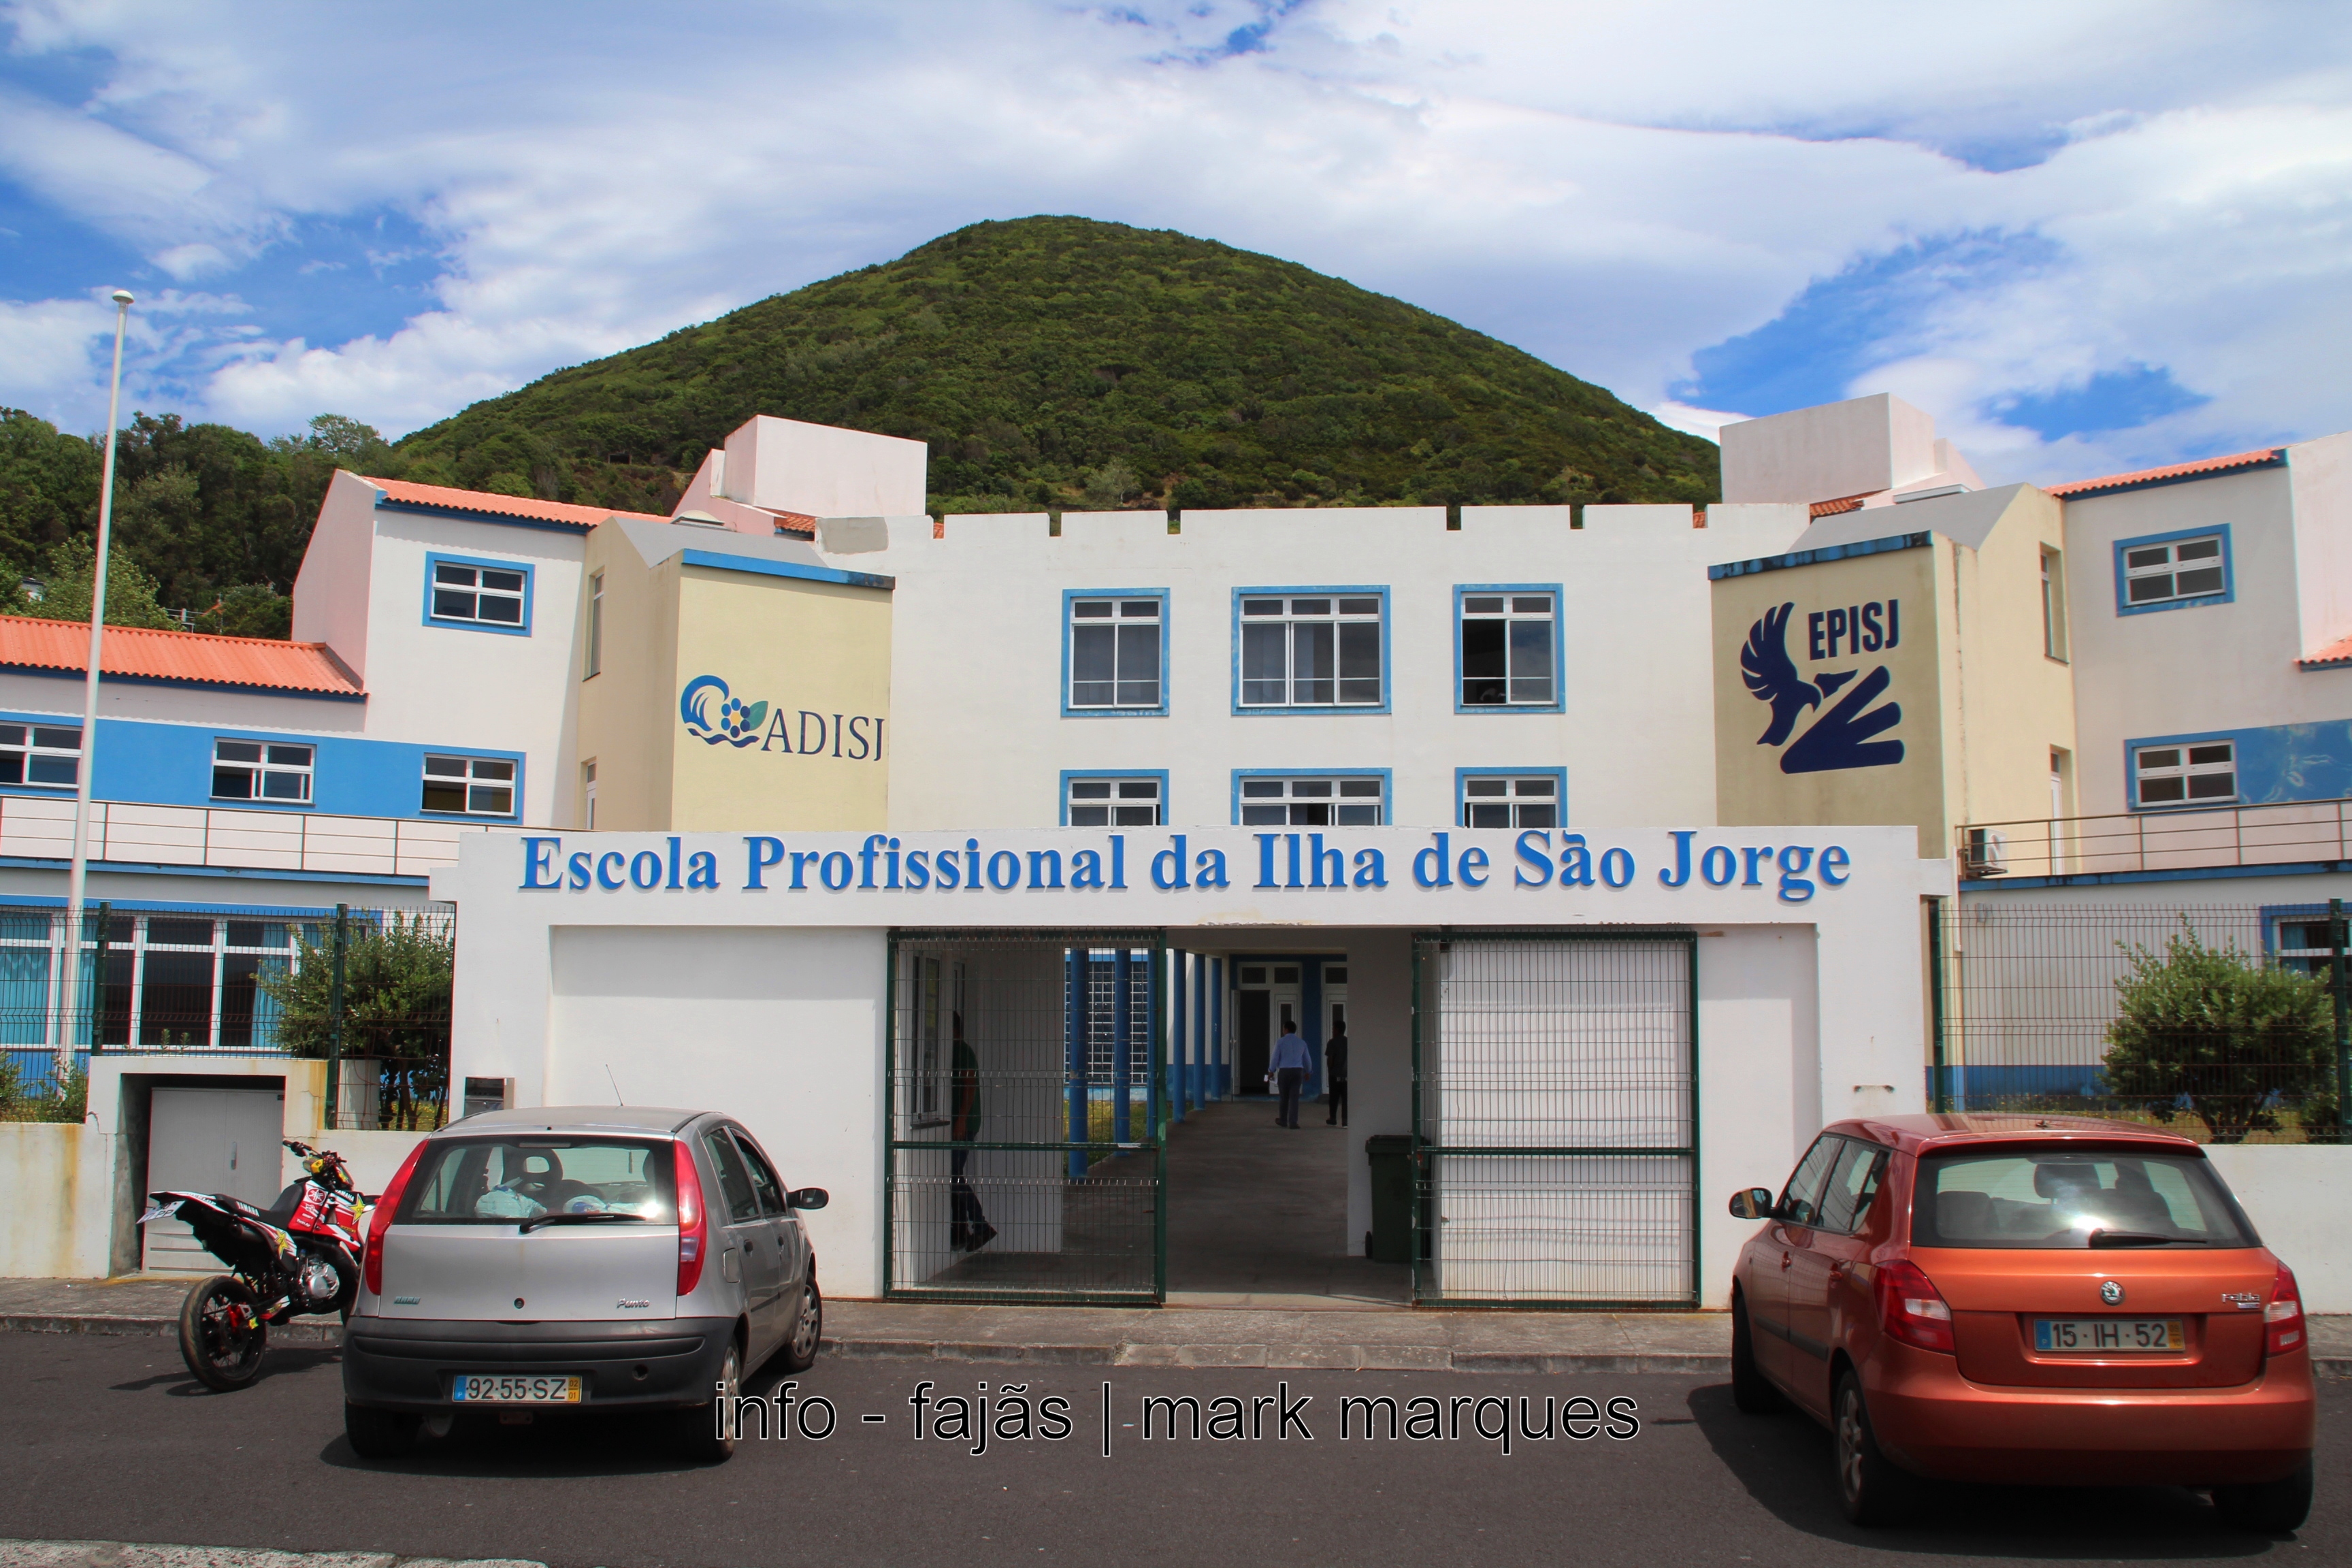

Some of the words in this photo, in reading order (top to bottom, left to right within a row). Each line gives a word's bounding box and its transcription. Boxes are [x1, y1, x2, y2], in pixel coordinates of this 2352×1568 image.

[1808, 599, 1899, 660] EPISJ
[760, 708, 885, 762] ADISJ
[518, 836, 719, 890] Escola
[742, 834, 1127, 890] Profissional
[1151, 834, 1230, 890] da
[1252, 832, 1389, 889] Ilha
[1412, 832, 1490, 887] de
[1515, 830, 1637, 888] São
[1659, 831, 1852, 903] Jorge
[235, 1200, 260, 1218] YAMAHA
[617, 1298, 651, 1309] Punto
[569, 1379, 578, 1388] 02
